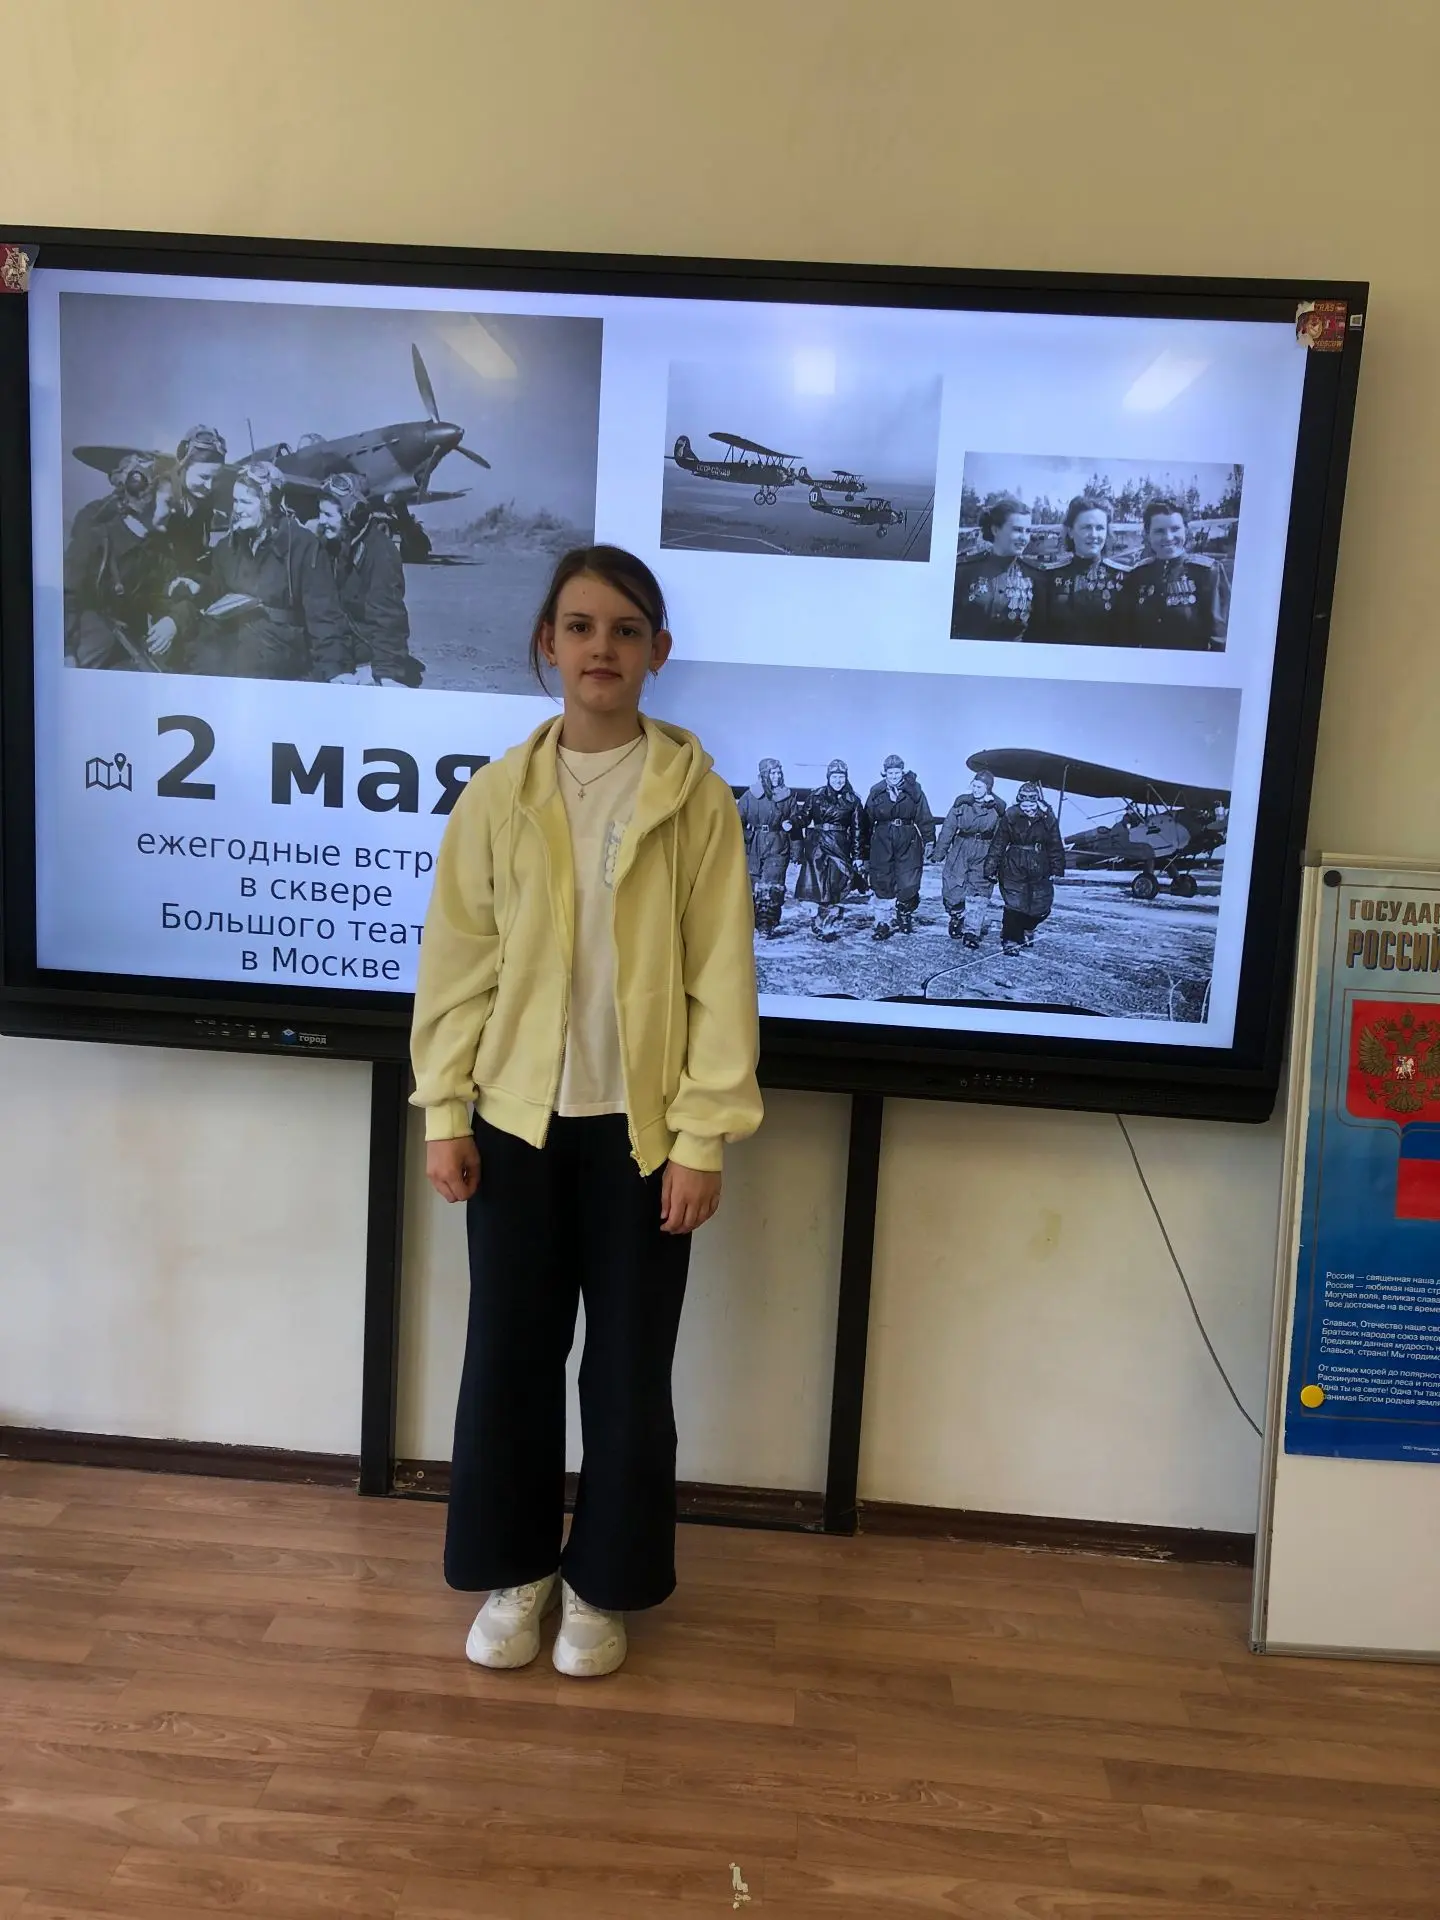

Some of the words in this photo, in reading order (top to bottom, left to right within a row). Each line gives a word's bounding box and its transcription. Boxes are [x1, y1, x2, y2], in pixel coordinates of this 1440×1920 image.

[157, 714, 216, 801] 2
[271, 741, 491, 816] мая
[137, 832, 341, 867] ежегодные
[354, 846, 438, 878] встр
[240, 876, 256, 898] в
[270, 878, 393, 911] сквере
[161, 902, 336, 941] Большого
[347, 919, 424, 946] теат
[242, 947, 257, 971] в
[272, 945, 401, 981] Москве
[299, 1034, 327, 1045] город
[1326, 1271, 1355, 1280] Россия
[1366, 1274, 1411, 1283] священная
[1325, 1281, 1354, 1289] Россия
[1365, 1283, 1403, 1292] любимая
[1404, 1286, 1426, 1294] наша
[1324, 1290, 1358, 1300] Могучая
[1382, 1294, 1415, 1302] великая
[1343, 1301, 1385, 1310] достоянье
[1322, 1318, 1359, 1328] Славься,
[1360, 1320, 1403, 1330] Отечество
[1404, 1324, 1427, 1332] наше
[1321, 1328, 1360, 1337] Братских
[1361, 1331, 1396, 1340] народов
[1320, 1336, 1362, 1346] Предками
[1363, 1340, 1394, 1349] данная
[1394, 1342, 1434, 1352] мудрость
[1320, 1345, 1356, 1356] Славься,
[1357, 1348, 1389, 1358] страна!
[1390, 1350, 1405, 1359] Мы
[1318, 1363, 1329, 1372] От
[1330, 1366, 1358, 1374] южных
[1360, 1367, 1387, 1376] морей
[1400, 1370, 1440, 1379] полярног
[1317, 1373, 1370, 1384] Раскинулись
[1363, 1386, 1389, 1394] свете!
[1390, 1386, 1412, 1396] Одна
[1323, 1393, 1357, 1402] анимая
[1358, 1394, 1384, 1403] Богом
[1385, 1397, 1415, 1405] родная
